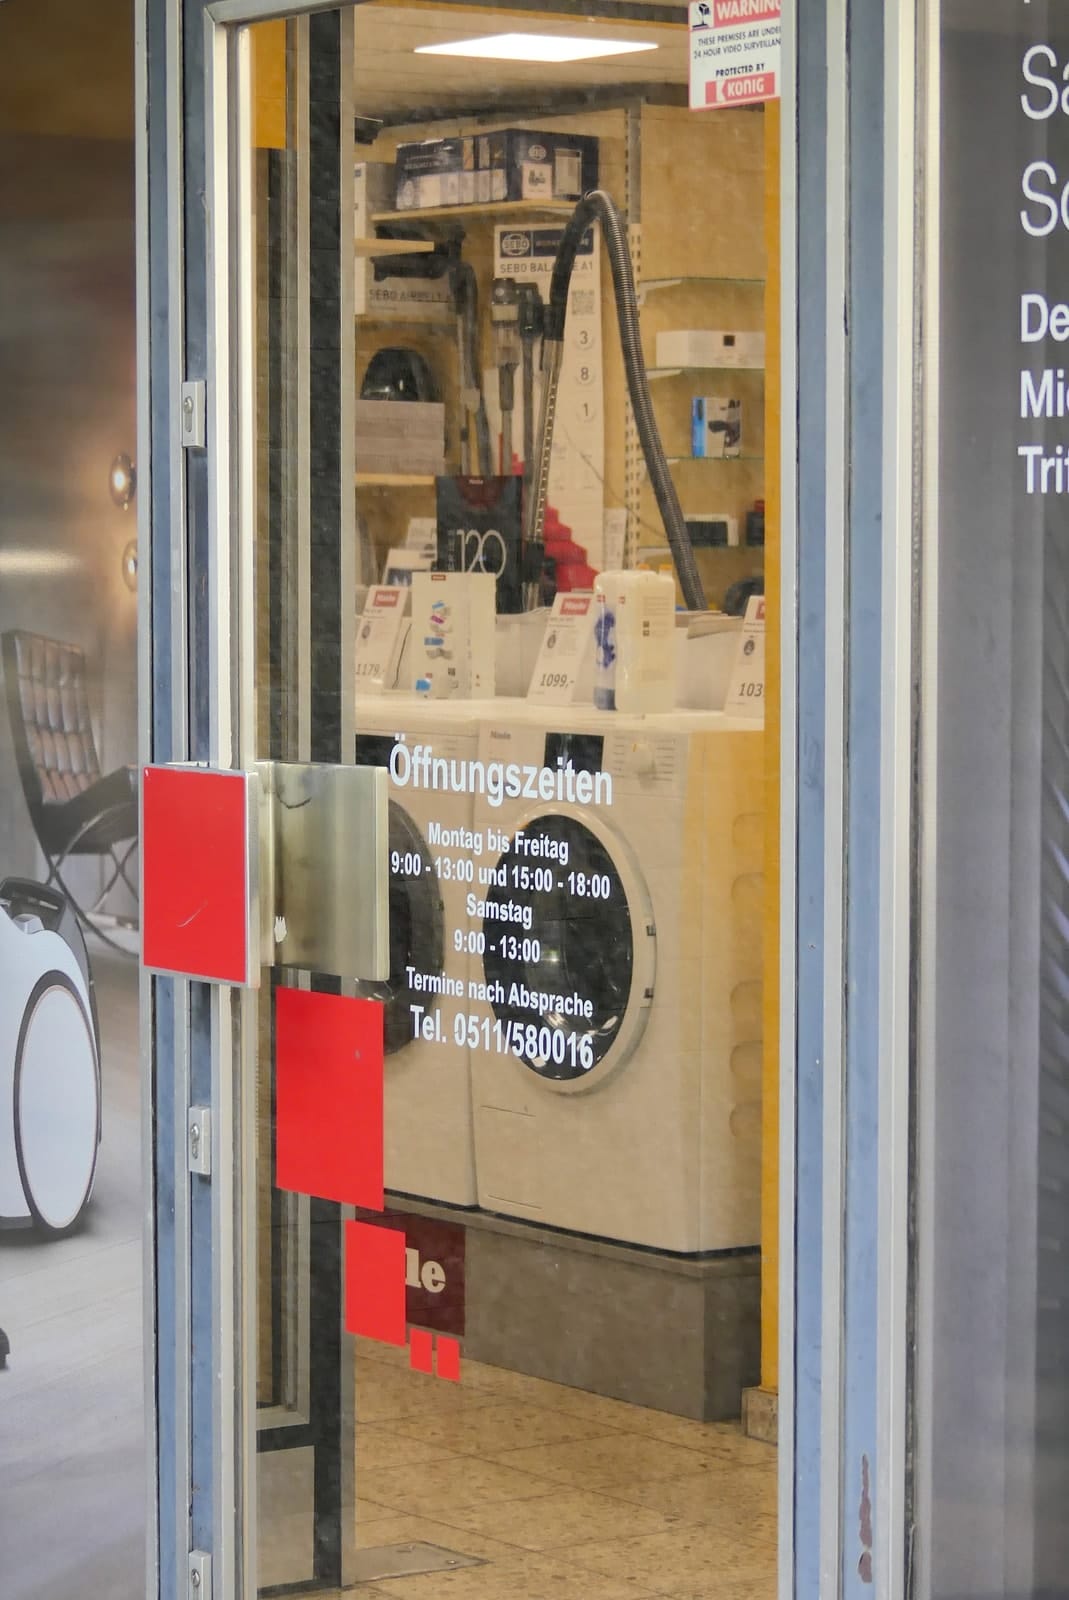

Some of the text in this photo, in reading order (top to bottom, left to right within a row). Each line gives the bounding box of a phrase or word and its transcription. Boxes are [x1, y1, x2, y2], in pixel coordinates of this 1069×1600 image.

[698, 26, 781, 46] THESE PREMISES ARE UNDE
[703, 47, 721, 57] HOUR
[723, 44, 742, 54] VIDEO
[744, 38, 781, 51] SURVEILLAN
[716, 63, 765, 77] PROTECTED BY
[1020, 161, 1069, 236] S
[500, 263, 527, 273] SEBO
[581, 261, 593, 271] A1
[580, 330, 588, 345] 3
[580, 367, 589, 381] 8
[583, 403, 589, 417] 1
[1020, 368, 1069, 418] Mi
[739, 682, 764, 697] 103
[389, 732, 612, 807] Öffnungszeiten
[428, 822, 569, 866] Montag bis Freitag
[391, 850, 421, 876] 9:00
[434, 856, 474, 882] 13:00
[478, 864, 507, 888] und
[511, 865, 552, 892] 15:00
[567, 871, 610, 899] 18:00
[466, 893, 532, 930] Samstag
[454, 929, 485, 954] 9:00
[499, 935, 541, 963] 13:00
[406, 966, 593, 1018] Termine nach Absprache
[410, 1004, 594, 1070] Tel. 0511/580016
[405, 1247, 446, 1294] le
